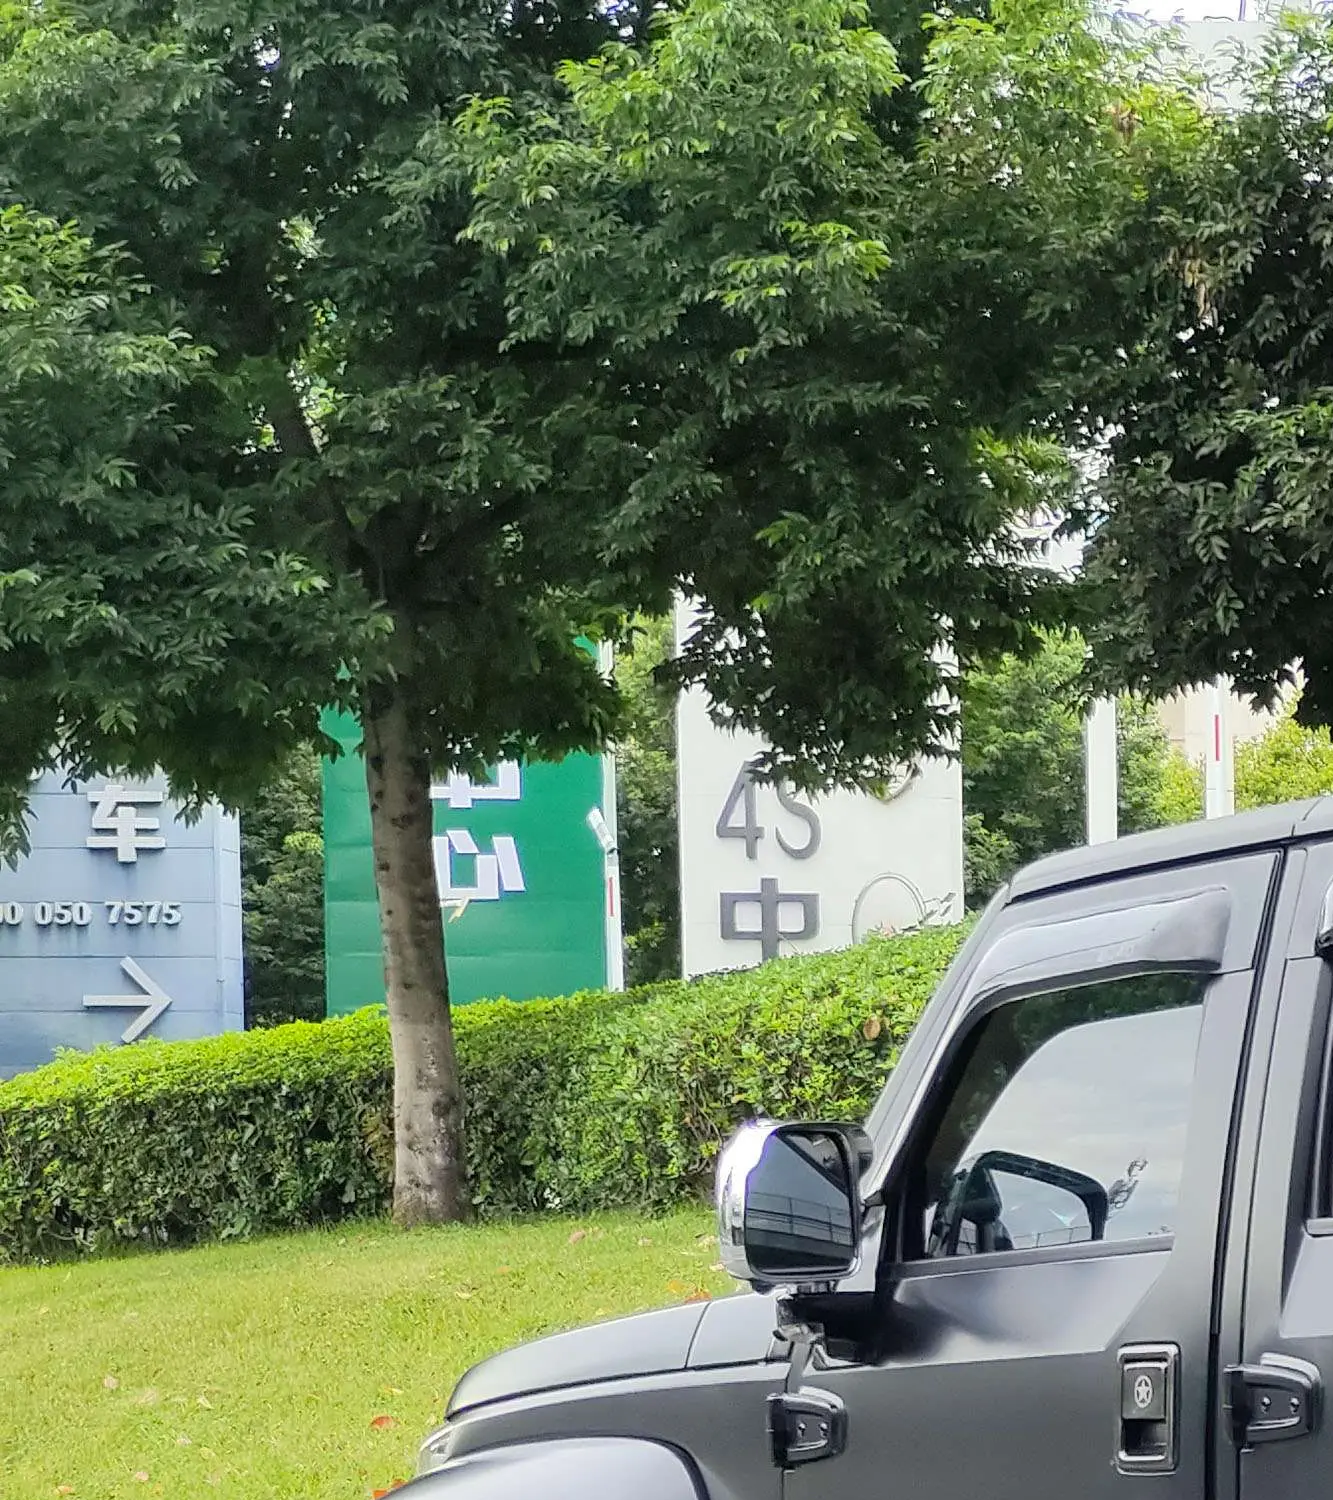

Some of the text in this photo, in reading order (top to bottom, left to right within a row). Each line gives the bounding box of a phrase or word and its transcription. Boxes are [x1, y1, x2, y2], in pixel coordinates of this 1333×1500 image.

[86, 785, 166, 864] 车
[715, 760, 821, 860] 4S
[0, 901, 182, 926] 0 050 7575
[719, 877, 820, 960] 中
